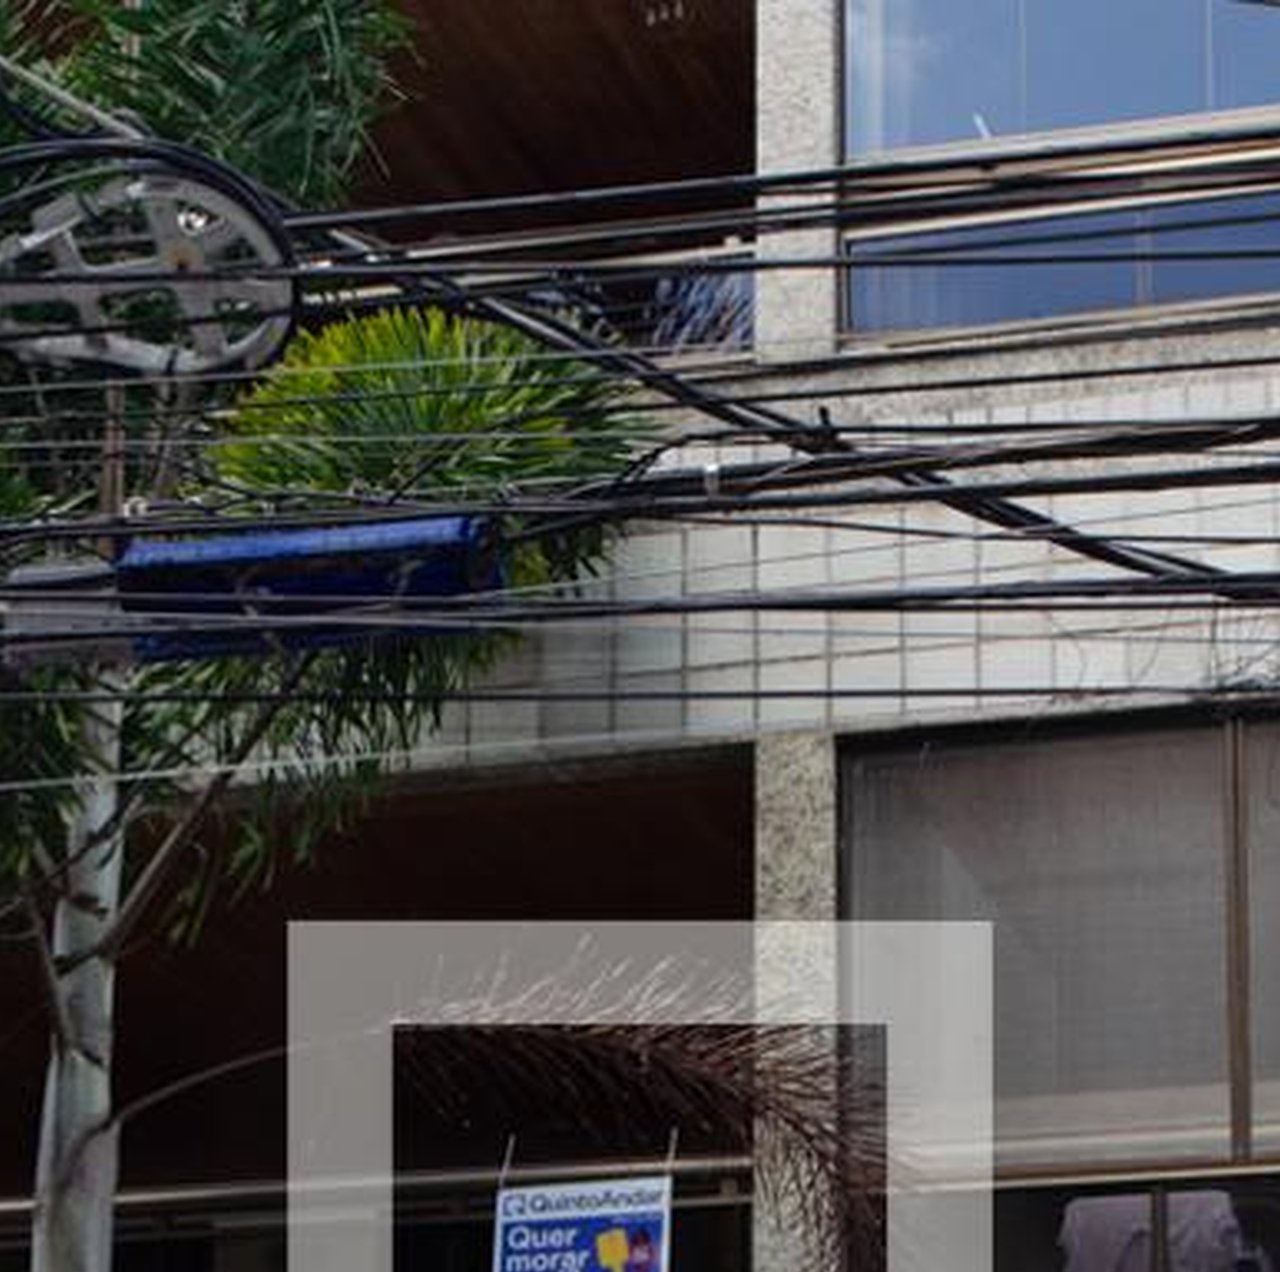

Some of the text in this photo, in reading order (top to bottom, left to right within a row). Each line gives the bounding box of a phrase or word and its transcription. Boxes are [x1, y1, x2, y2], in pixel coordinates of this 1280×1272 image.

[529, 1188, 664, 1214] QuintoAndar
[507, 1226, 578, 1250] Quer
[506, 1250, 590, 1272] morar
